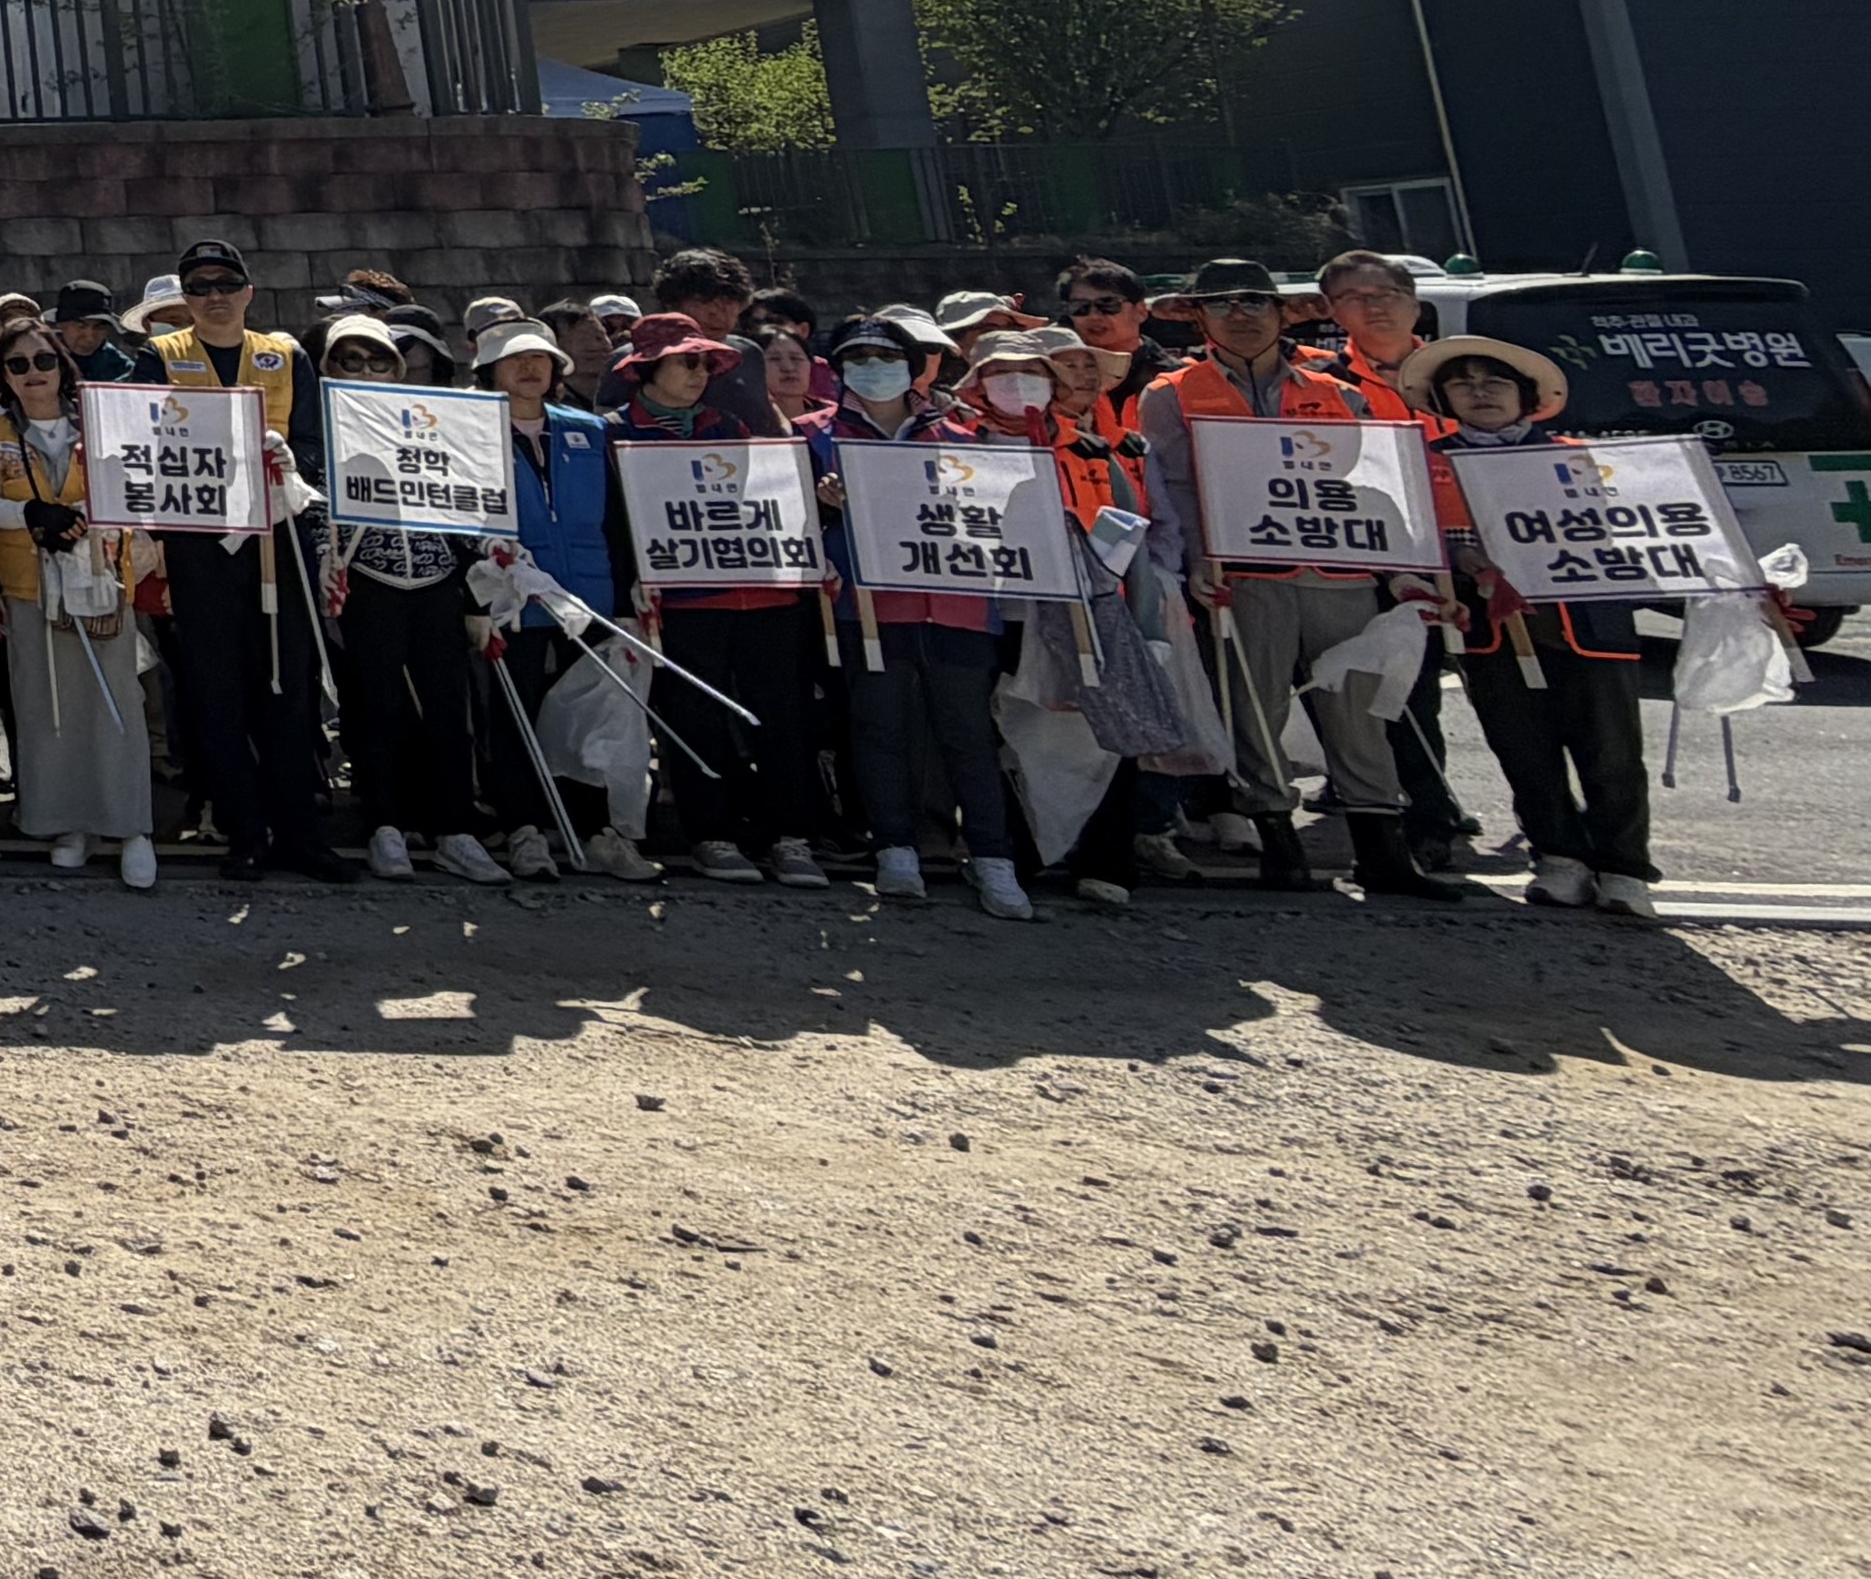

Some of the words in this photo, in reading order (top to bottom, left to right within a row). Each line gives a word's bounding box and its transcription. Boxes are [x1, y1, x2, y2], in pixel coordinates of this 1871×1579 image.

[120, 444, 227, 481] 적십자
[395, 444, 451, 477] 청학
[123, 482, 227, 516] 봉사회
[345, 473, 508, 517] 배드민턴클럽
[1266, 478, 1358, 512] 의용
[665, 498, 783, 531] 바르게
[916, 501, 1004, 540] 생활
[1249, 514, 1390, 552] 소방대
[1505, 502, 1711, 543] 여성의용
[646, 535, 818, 570] 살기협의회
[901, 542, 1032, 581] 개선회
[1547, 543, 1705, 583] 소방대
